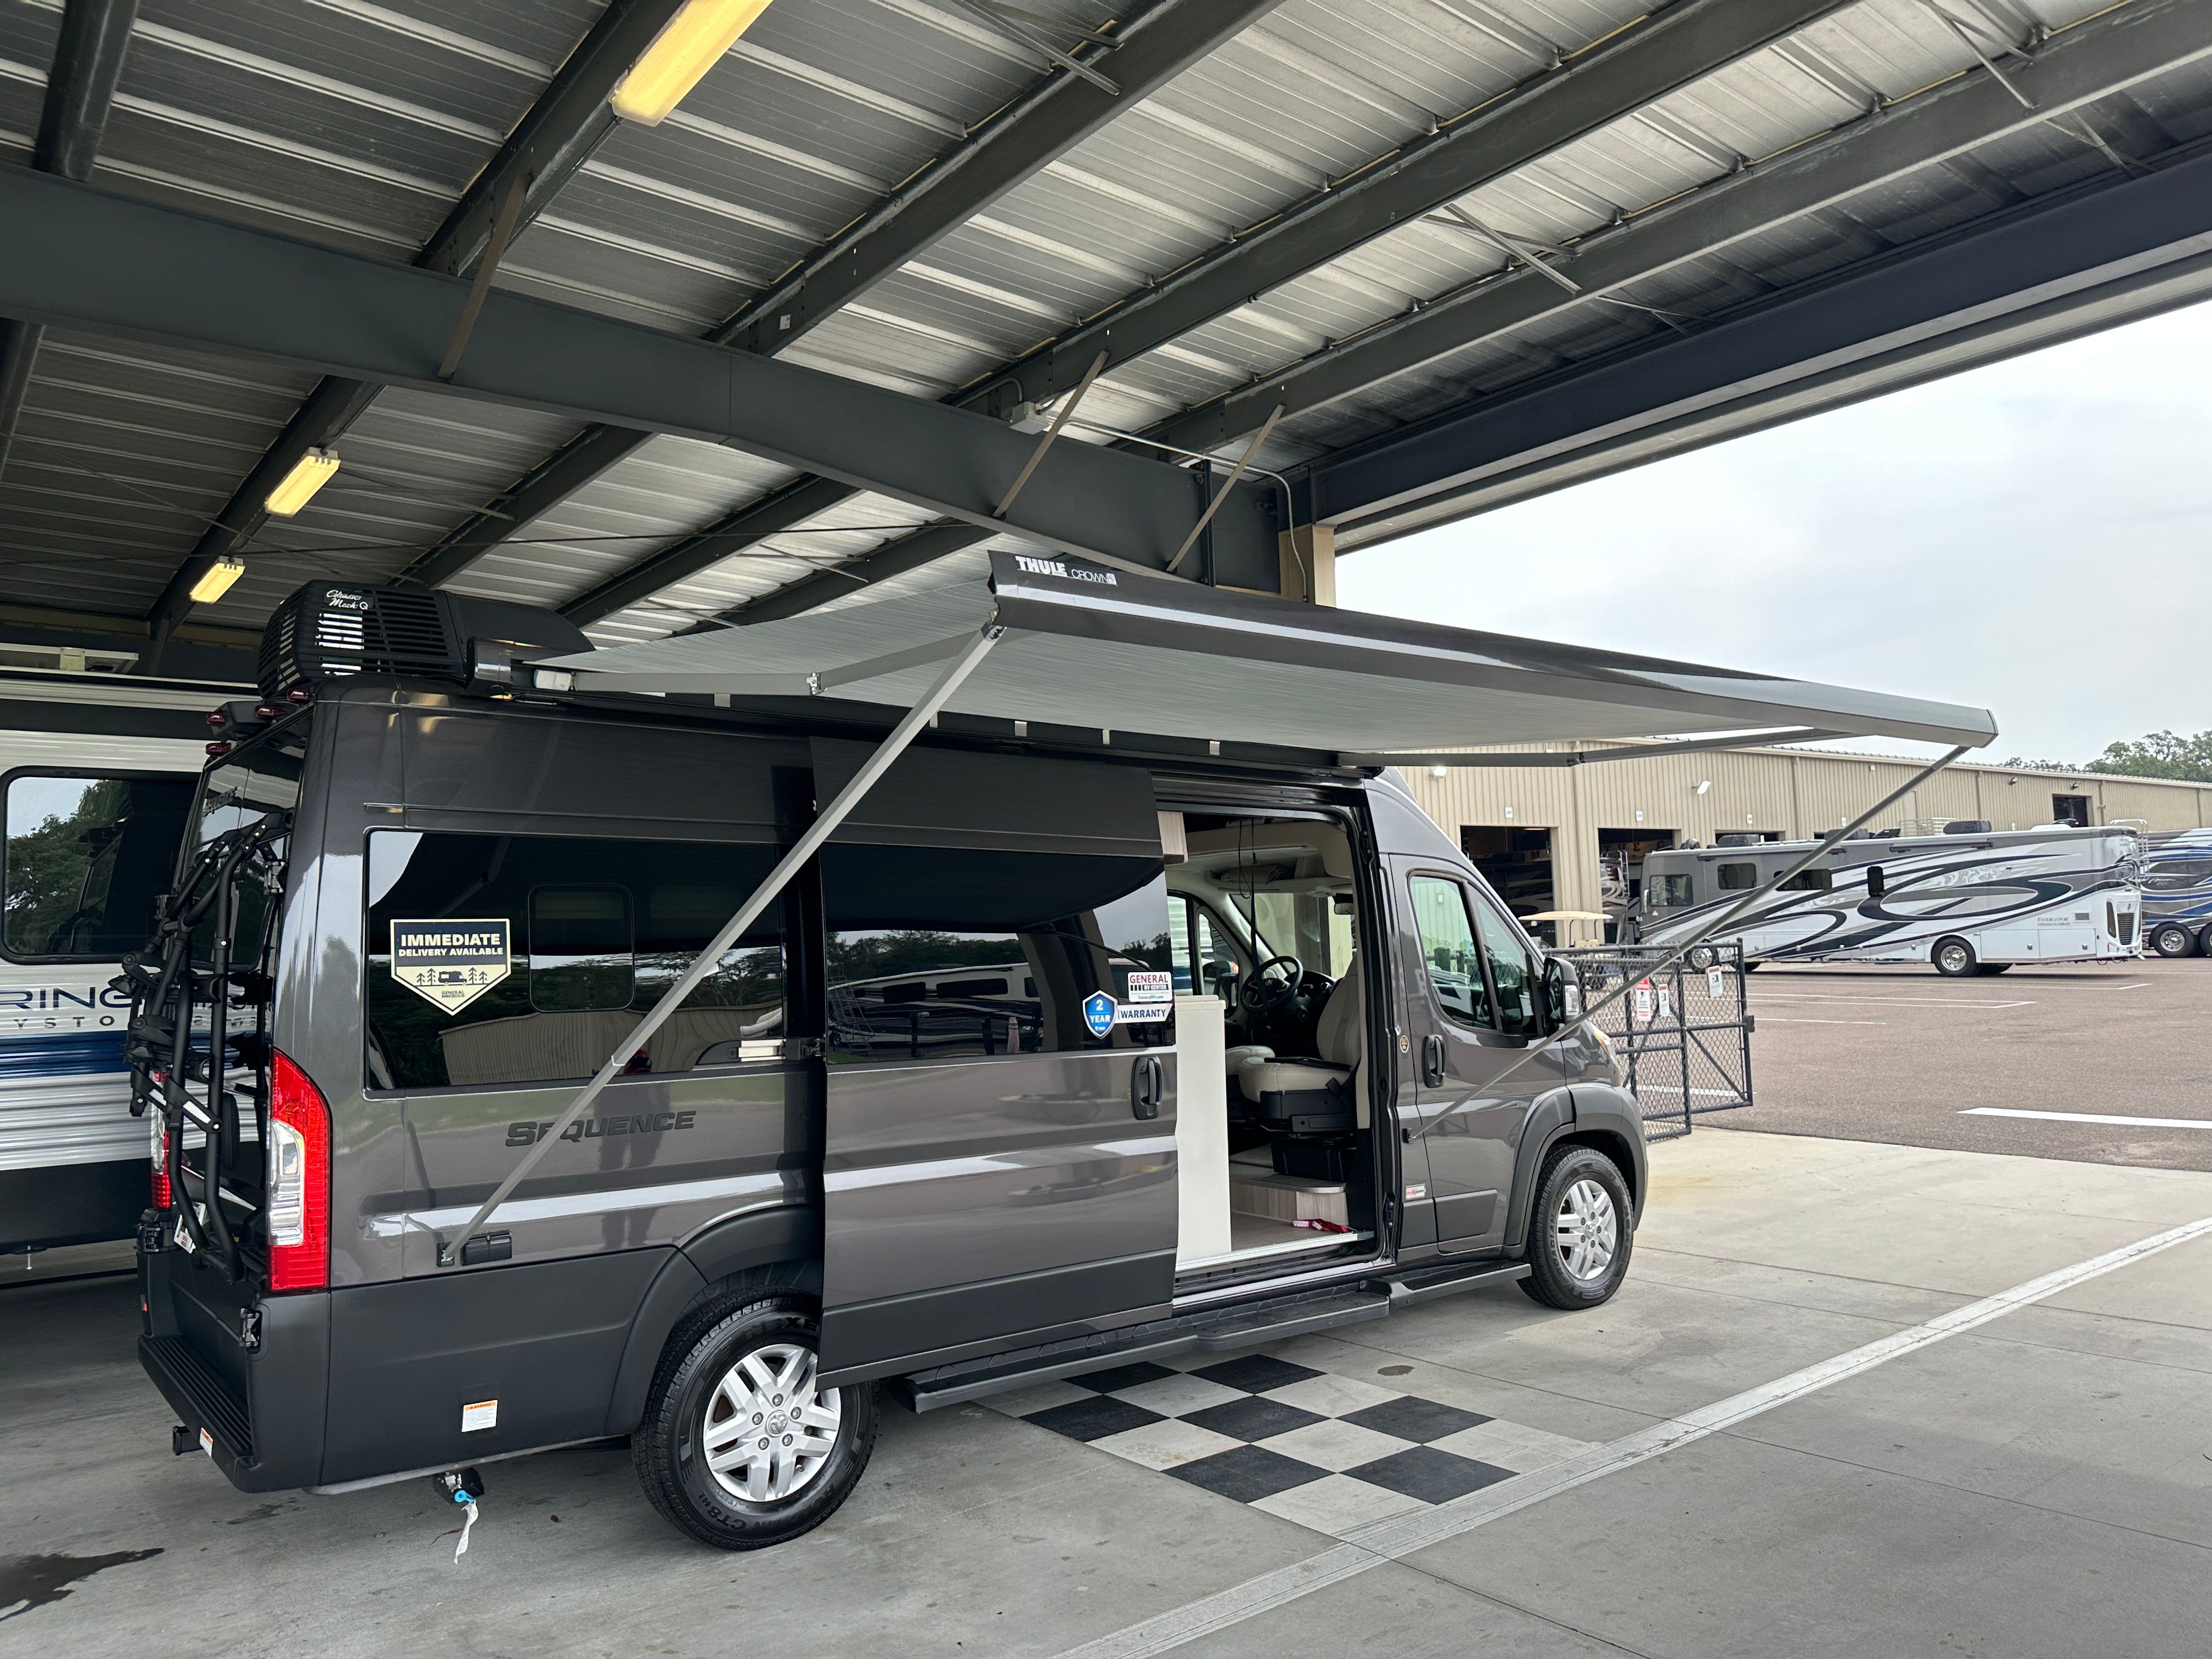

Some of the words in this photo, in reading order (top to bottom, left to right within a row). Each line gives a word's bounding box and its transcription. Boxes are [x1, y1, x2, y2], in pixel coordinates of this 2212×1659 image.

[1015, 556, 1067, 577] THULE
[1071, 569, 1108, 583] CROWN
[401, 933, 500, 946] IMMEDIATE
[399, 948, 447, 957] DELIVERY
[449, 947, 504, 956] AVAILABLE
[1130, 974, 1169, 984] GENERAL
[1096, 999, 1103, 1011] 2
[1089, 1014, 1110, 1023] YEAR
[1120, 1008, 1166, 1019] WARRANTY
[706, 1505, 747, 1531] CT8
